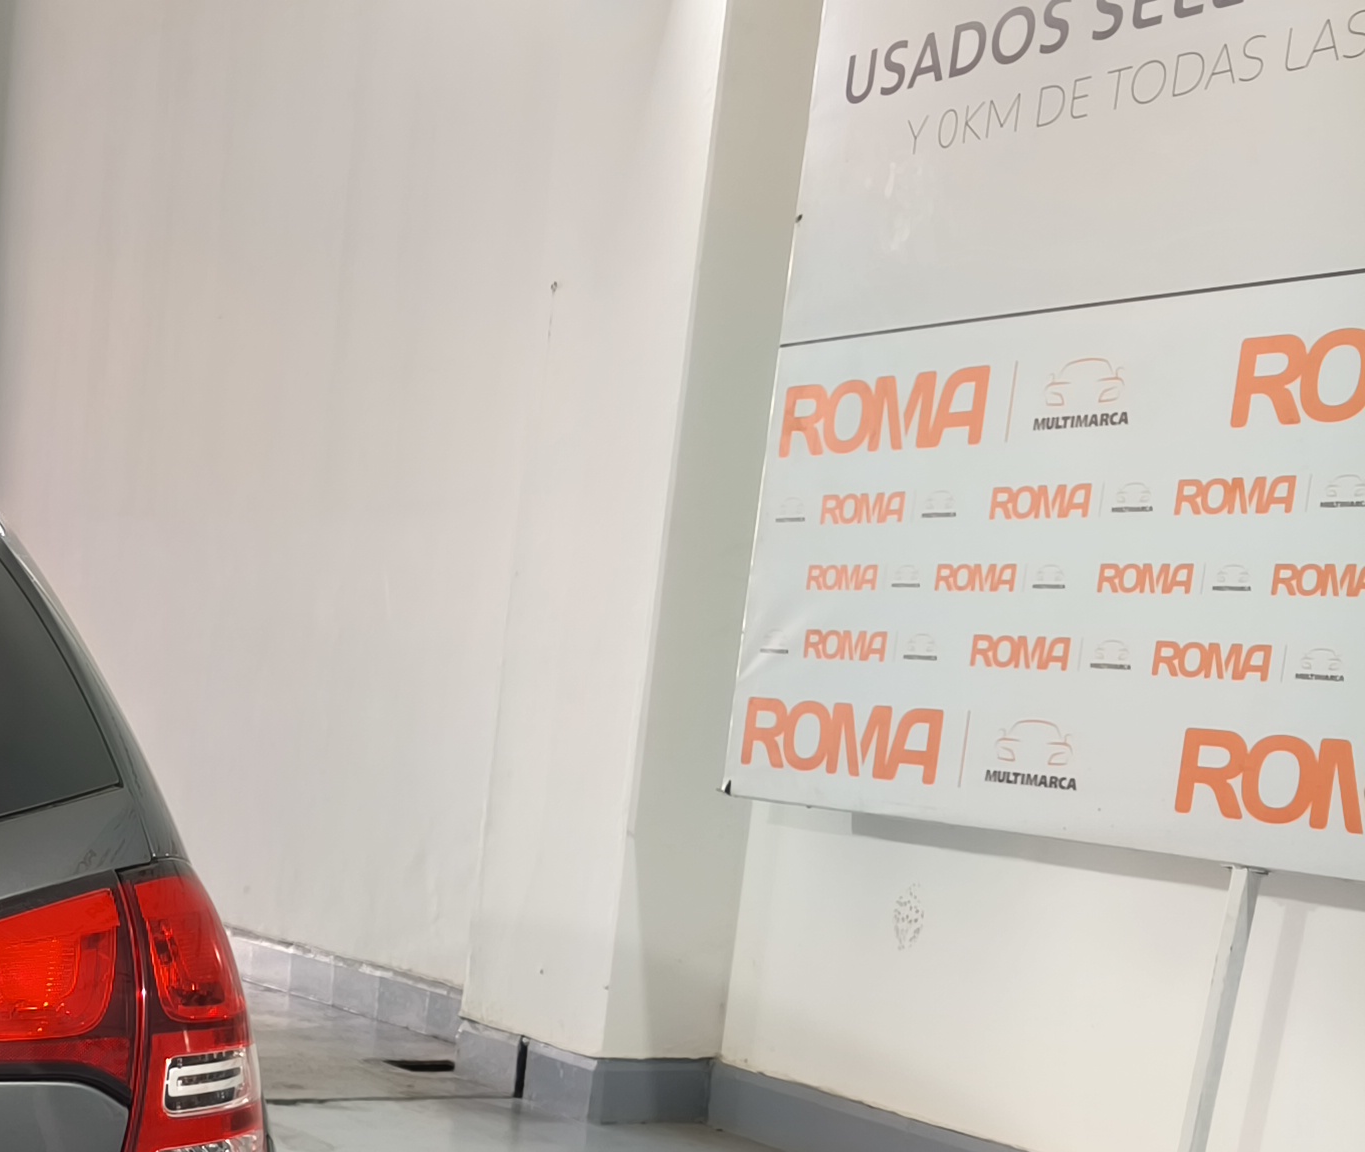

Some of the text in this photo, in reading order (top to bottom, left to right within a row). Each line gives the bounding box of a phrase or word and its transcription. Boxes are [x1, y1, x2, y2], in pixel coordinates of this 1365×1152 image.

[844, 0, 1244, 104] USADOS SE
[907, 115, 929, 155] Y
[1036, 76, 1093, 129] DE
[1107, 35, 1267, 110] TODAS
[1230, 328, 1365, 428] RO
[778, 365, 1129, 458] ROMA MULTIMARCA
[820, 491, 905, 525] ROMA
[989, 483, 1092, 520] ROMA
[1174, 475, 1297, 516] ROMA
[805, 563, 878, 591] ROMA
[934, 563, 1017, 592] ROMA
[1097, 563, 1194, 594] ROMA
[803, 629, 888, 662] ROMA
[969, 634, 1071, 671] ROMA
[1151, 640, 1272, 682] ROMA
[741, 696, 1077, 791] ROMA MULTIMARCA
